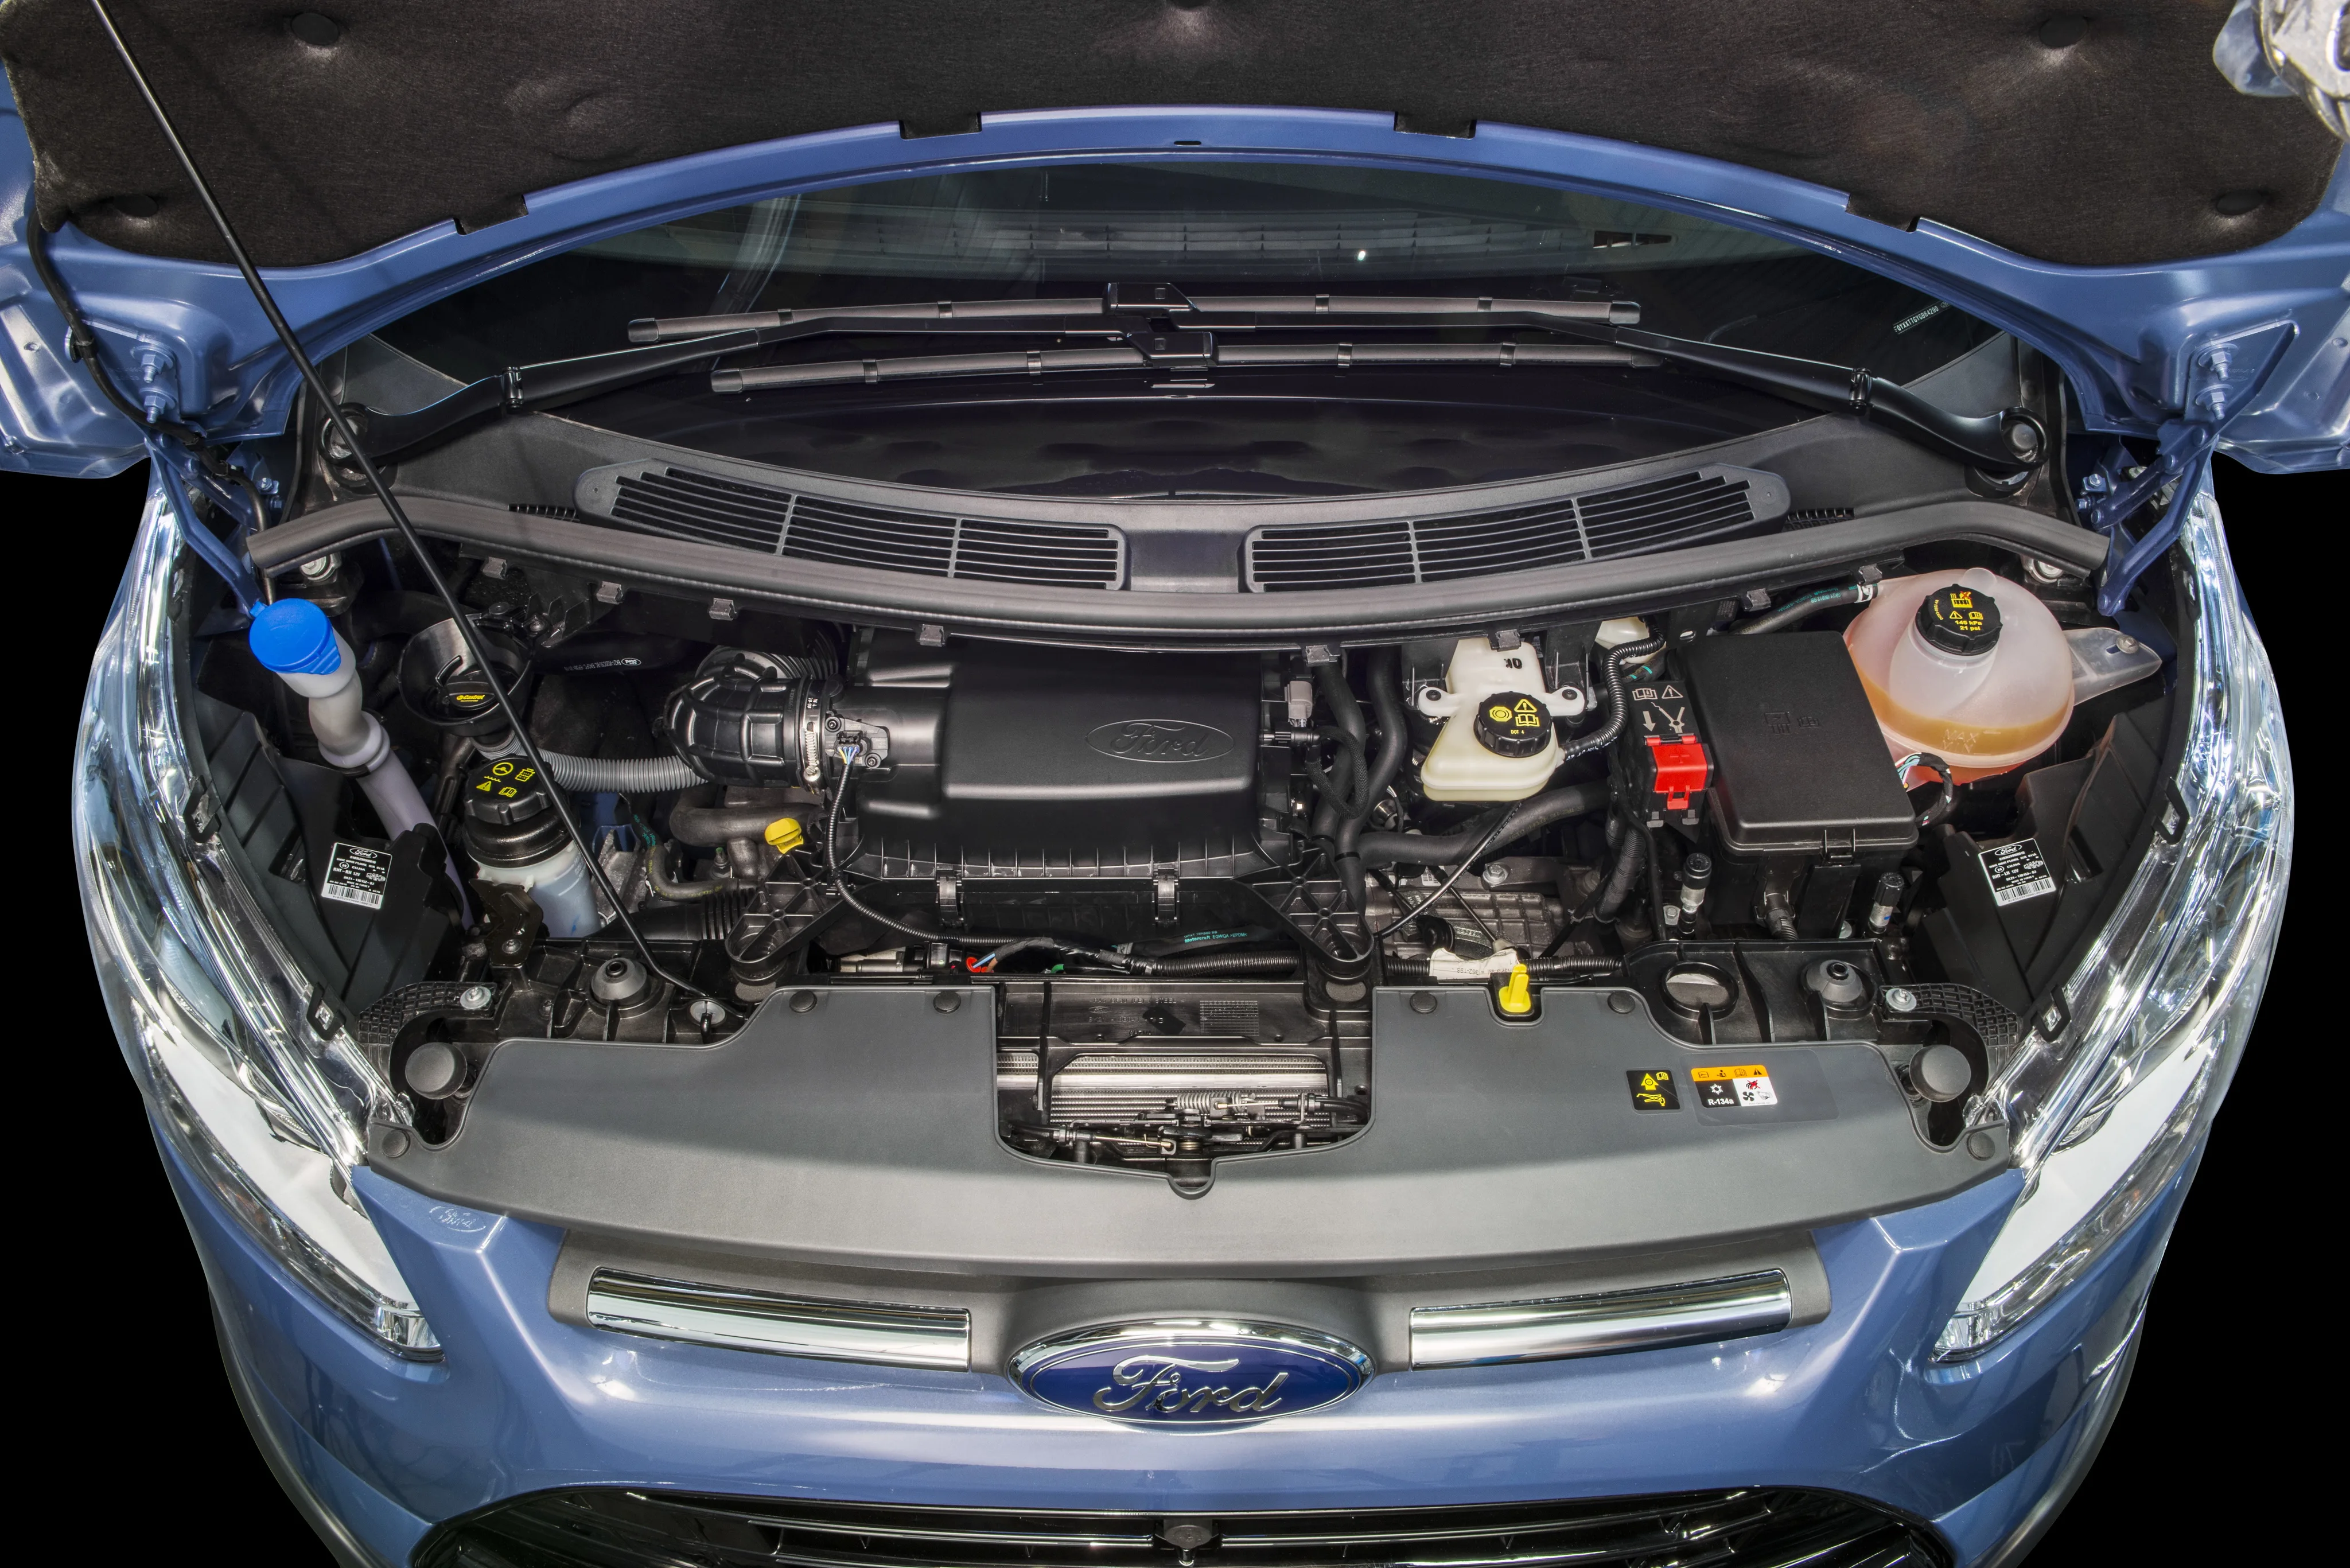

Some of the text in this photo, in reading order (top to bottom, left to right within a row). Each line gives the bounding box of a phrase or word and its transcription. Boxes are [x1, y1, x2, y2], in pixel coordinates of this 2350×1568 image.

[1110, 723, 1209, 756] Ford
[355, 849, 372, 857] Ford
[2000, 846, 2017, 854] Ford
[1457, 967, 1479, 975] 362-198
[1093, 1355, 1288, 1413] Ford
